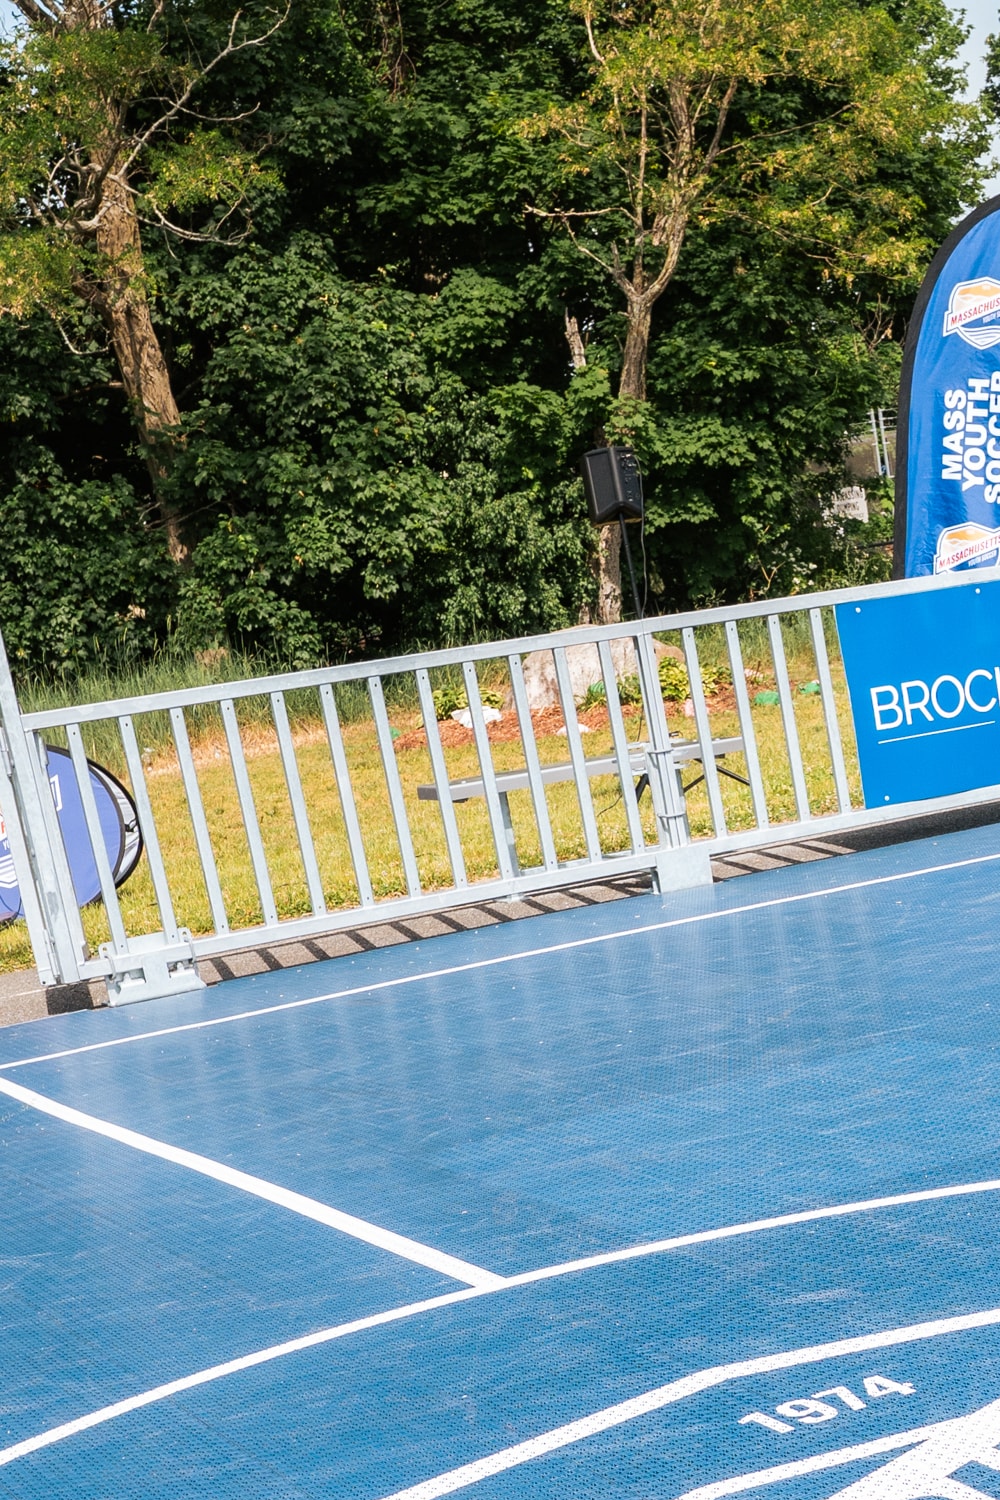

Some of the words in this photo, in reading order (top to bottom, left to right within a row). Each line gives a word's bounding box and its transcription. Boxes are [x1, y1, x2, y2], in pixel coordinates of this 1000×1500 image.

[941, 389, 967, 480] MASS
[962, 378, 991, 491] YOUTH
[737, 1374, 917, 1434] 1974
